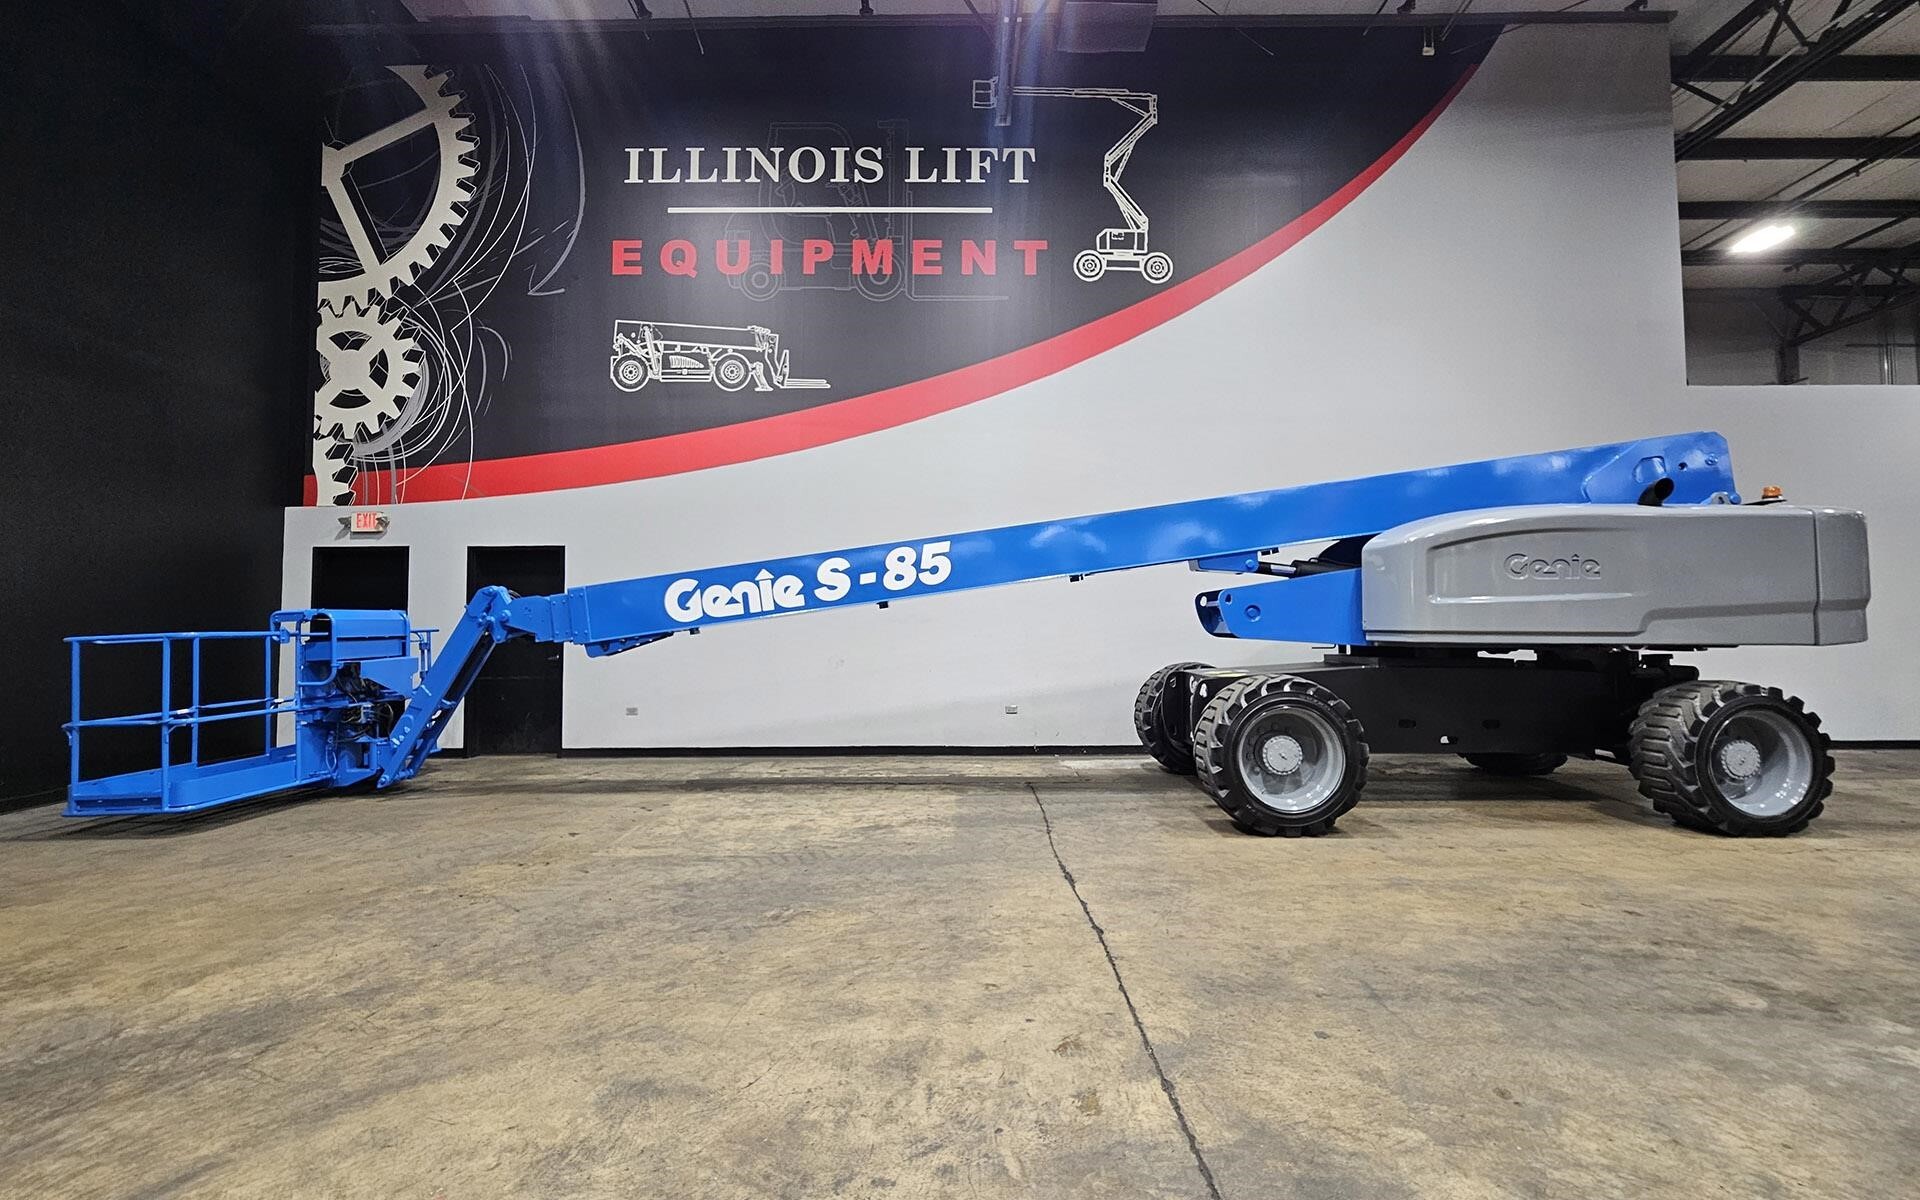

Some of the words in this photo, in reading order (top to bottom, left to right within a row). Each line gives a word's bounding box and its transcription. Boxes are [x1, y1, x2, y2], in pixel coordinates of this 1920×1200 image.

[624, 146, 883, 183] ILLINOIS
[904, 147, 1036, 183] LIFT
[611, 239, 1048, 278] EQUIPMENT
[356, 512, 377, 529] EXIT
[1503, 553, 1602, 581] Genie
[664, 568, 806, 623] Genie
